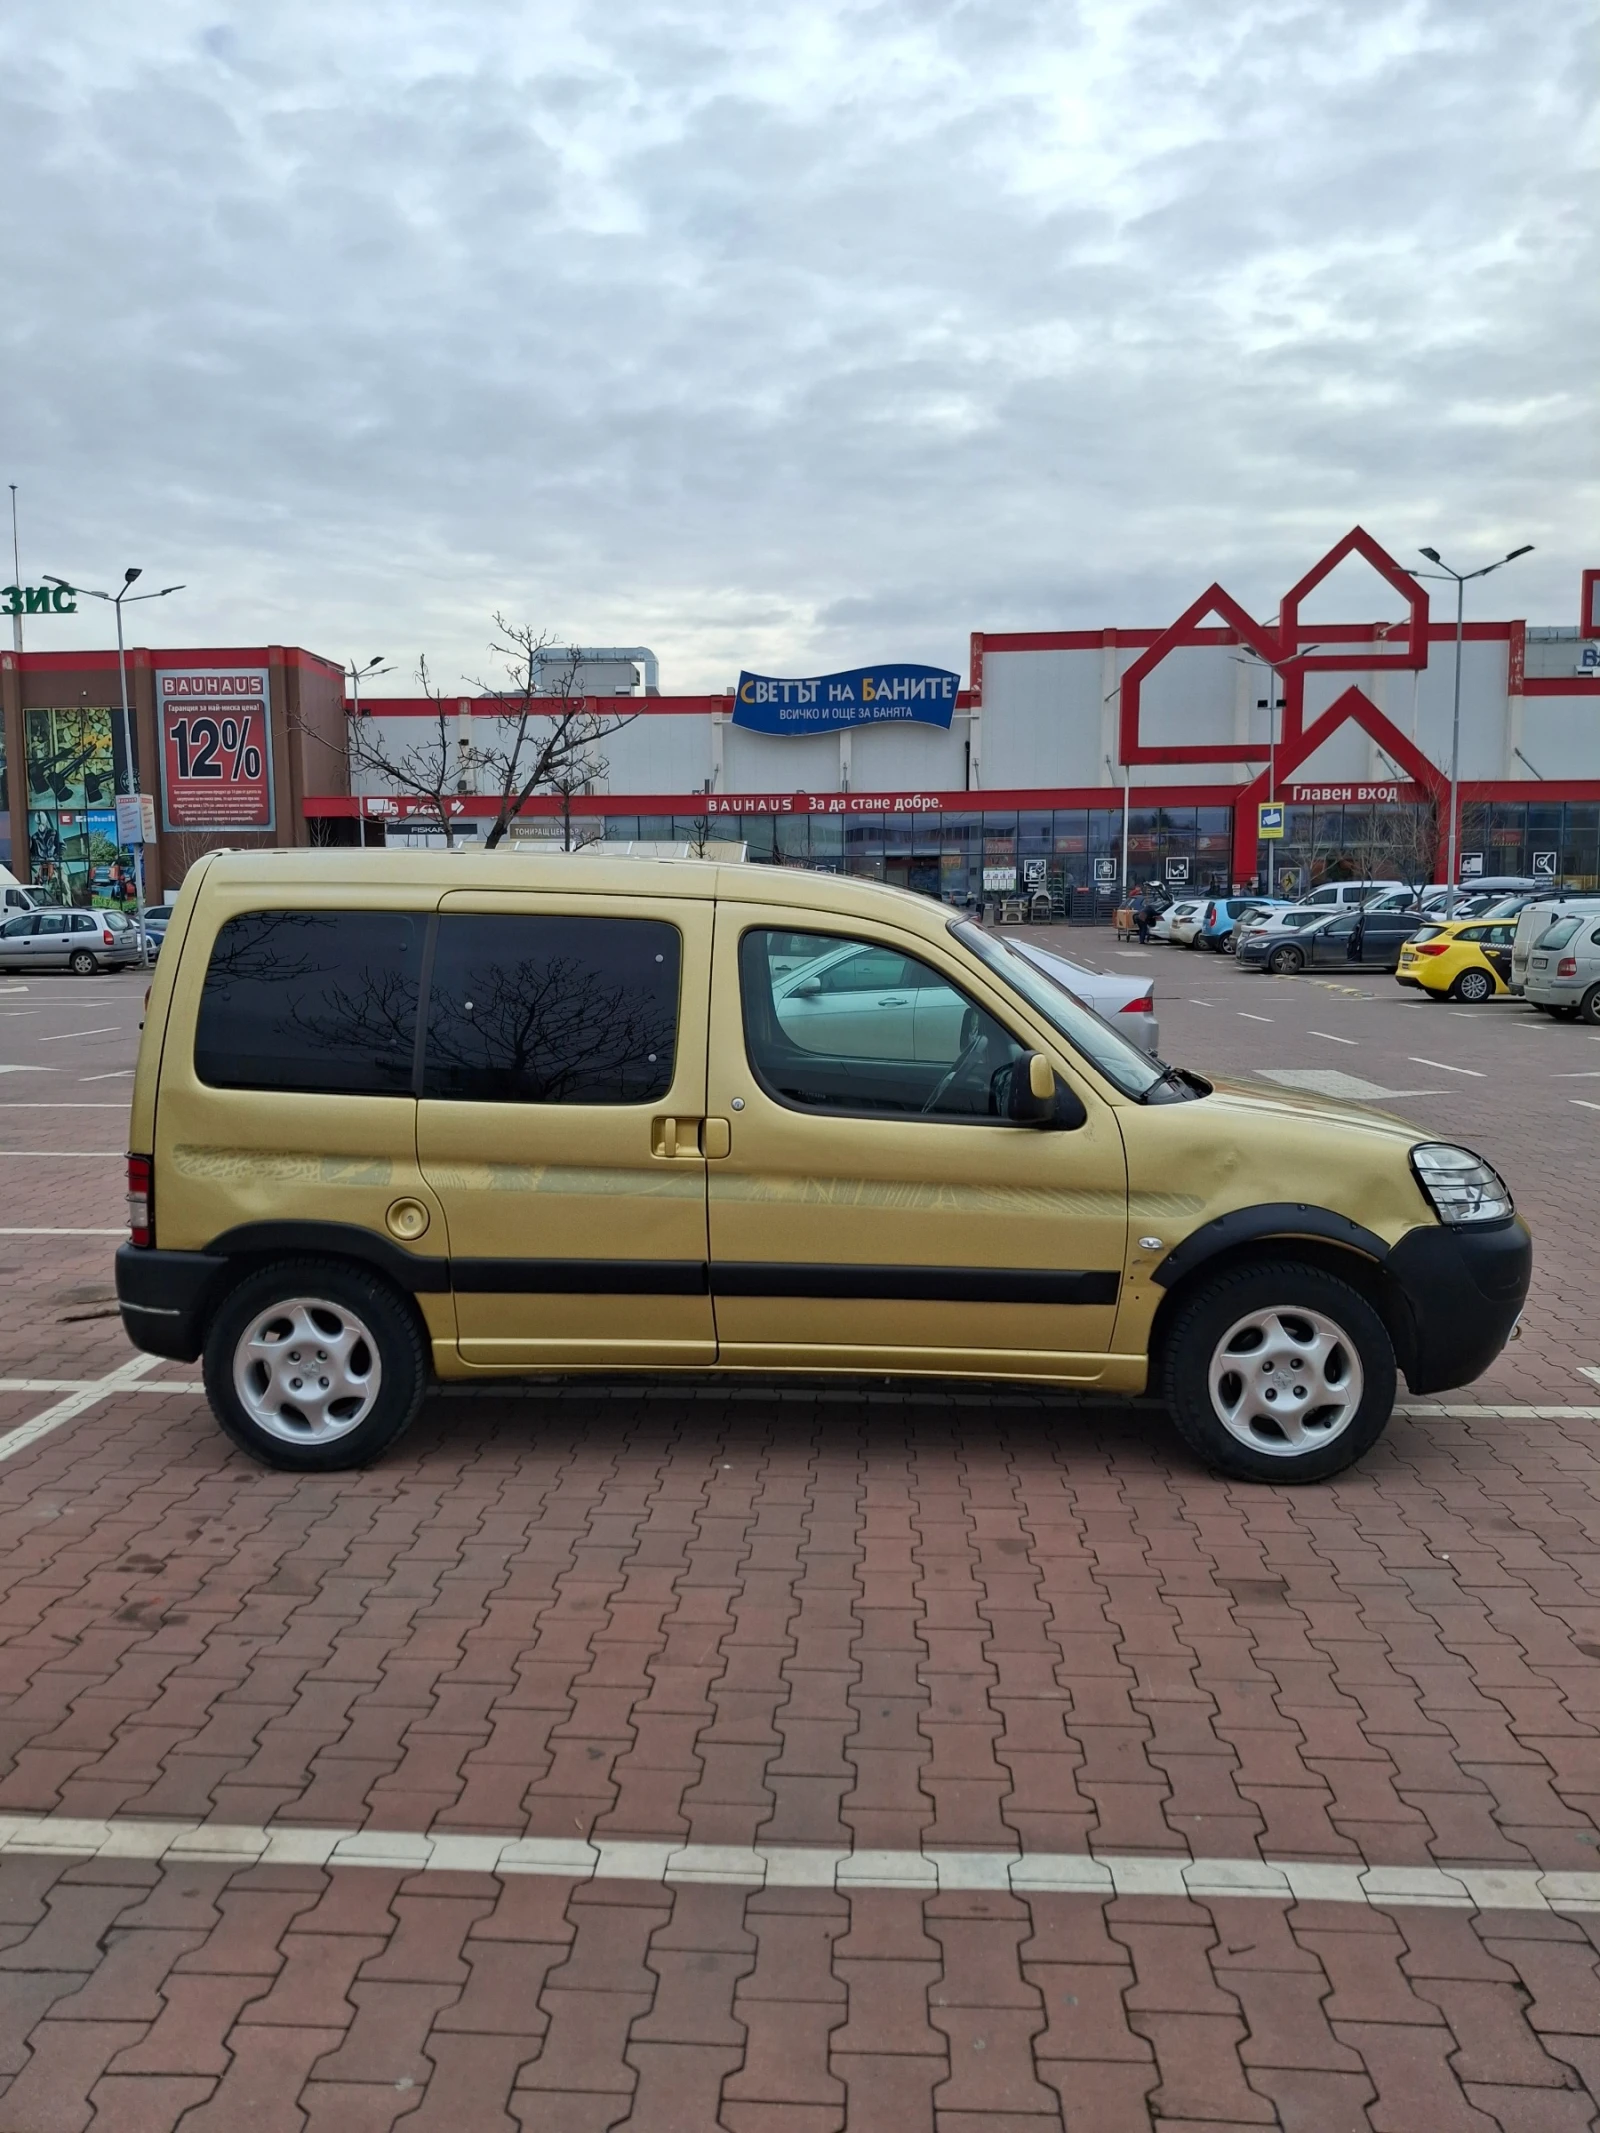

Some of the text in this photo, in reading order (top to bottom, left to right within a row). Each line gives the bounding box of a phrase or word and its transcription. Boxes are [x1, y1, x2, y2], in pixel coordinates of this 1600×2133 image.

[164, 679, 261, 693] BAUHAUS
[740, 680, 821, 704] СВЕТЪТ
[828, 684, 855, 702] НА
[168, 704, 199, 714] Гаранция
[208, 703, 241, 712] най-ниска
[241, 703, 260, 712] цена!
[779, 705, 913, 720] ВСИЧКО И ОЩЕ ЗА БАНЯТА
[169, 716, 262, 781] 12%
[1292, 785, 1398, 803] Главен вход
[708, 799, 793, 812] BAUHAUS
[808, 795, 943, 812] За да стане добре.
[550, 827, 579, 836] ЦЕНЪР
